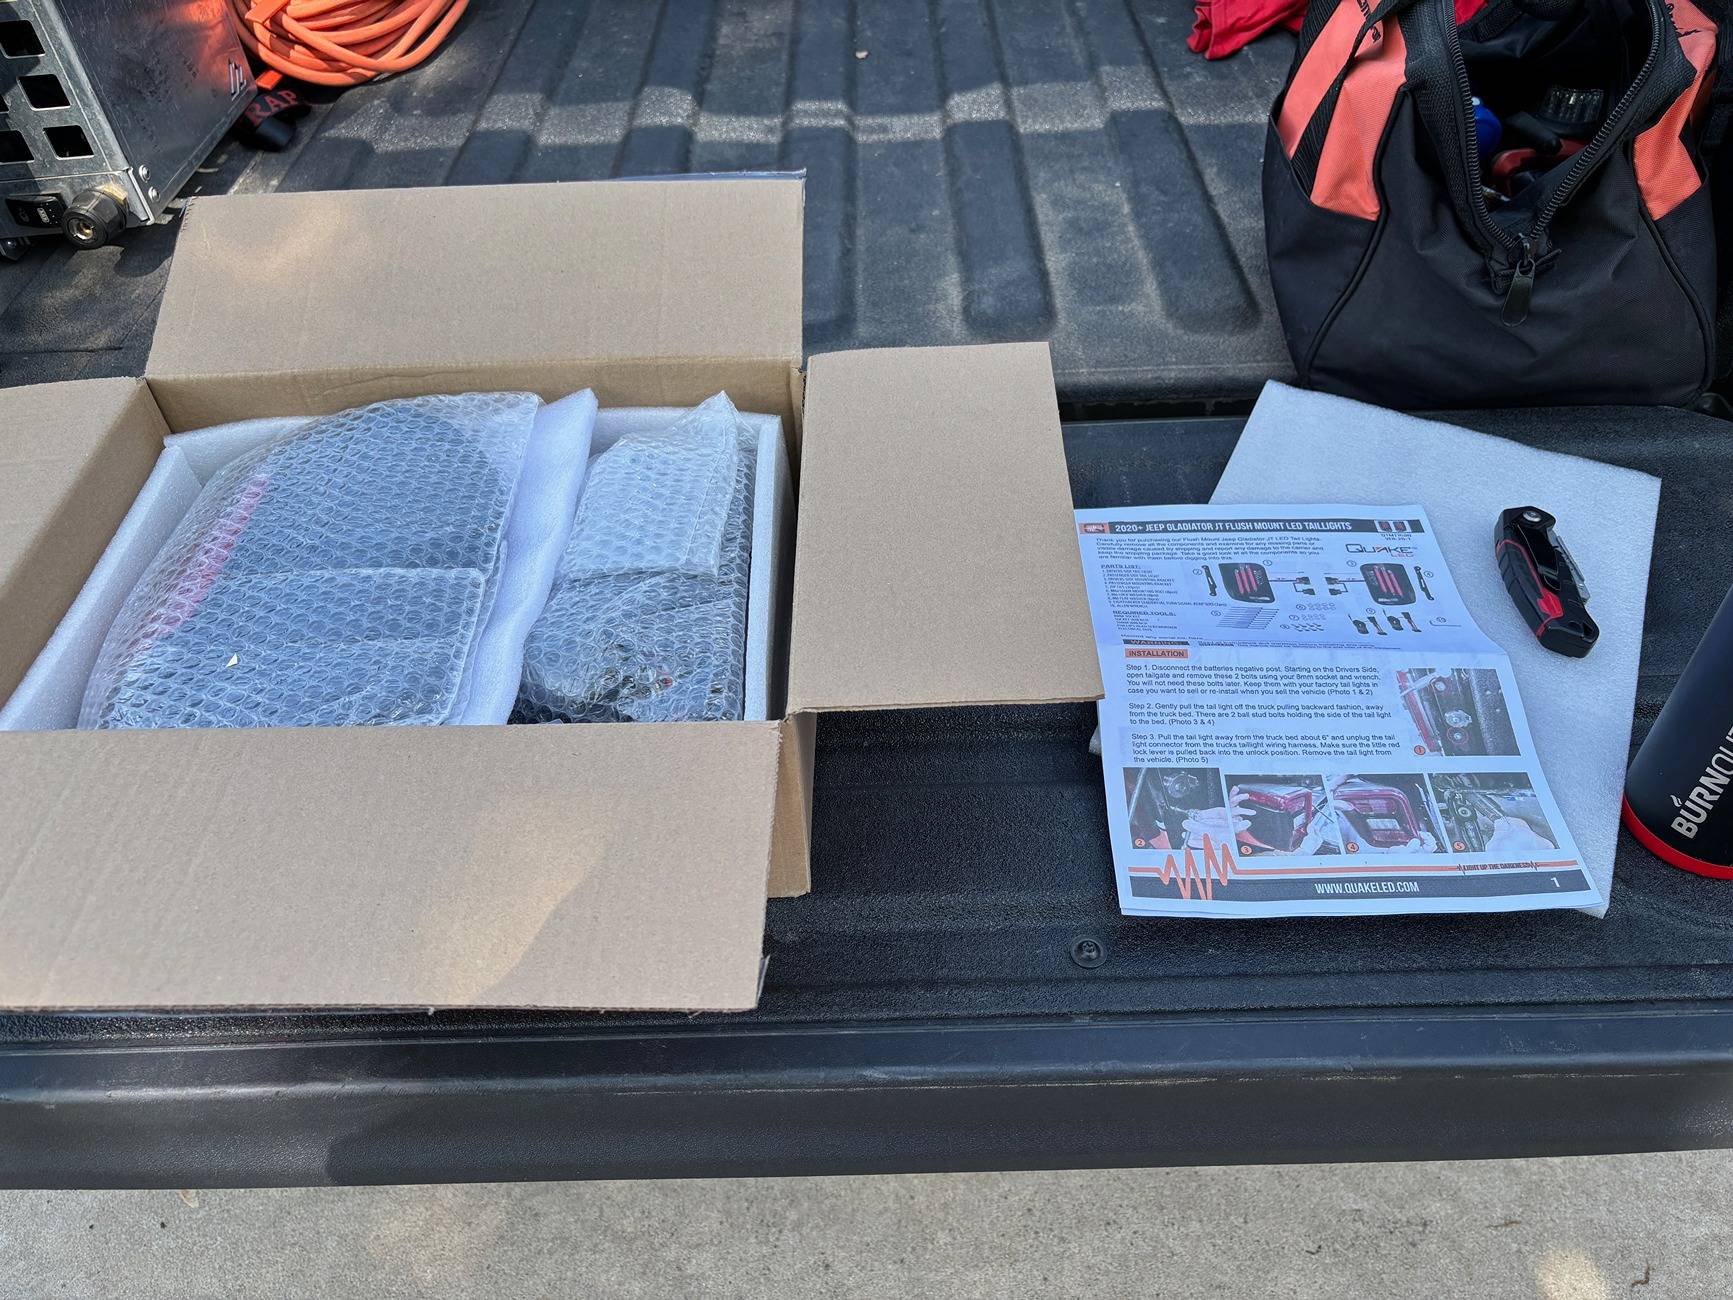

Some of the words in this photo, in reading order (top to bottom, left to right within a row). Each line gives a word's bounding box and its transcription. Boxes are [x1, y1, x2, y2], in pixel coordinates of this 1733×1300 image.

[1114, 524, 1143, 532] 2020+
[1145, 523, 1164, 532] JEEP
[1166, 523, 1213, 531] GLADIATOR
[1214, 523, 1223, 531] JT
[1224, 522, 1253, 531] FLUSH
[1253, 522, 1284, 530] MOUNT
[1285, 522, 1303, 530] LED
[1303, 522, 1352, 530] TAILLIGHTS
[1125, 664, 1142, 672] Step
[1234, 665, 1264, 673] negative
[1284, 665, 1311, 673] Starting
[1144, 672, 1170, 680] tailgate
[1258, 673, 1278, 681] using
[1243, 680, 1262, 688] Keep
[1314, 681, 1338, 689] factory
[1351, 681, 1370, 689] lights
[1327, 688, 1350, 696] (Photo
[1217, 703, 1233, 711] light
[1276, 703, 1299, 711] pulling
[1286, 711, 1312, 719] holding
[1376, 711, 1391, 719] light
[1131, 733, 1148, 741] Step
[1197, 733, 1213, 741] light
[1345, 734, 1370, 742] unplug
[1131, 741, 1147, 749] light
[1270, 749, 1300, 757] position.
[1358, 749, 1374, 757] light
[1175, 756, 1199, 764] (Photo
[1550, 877, 1560, 887] 1
[1314, 881, 1420, 894] WWW.QUAKELED.COM
